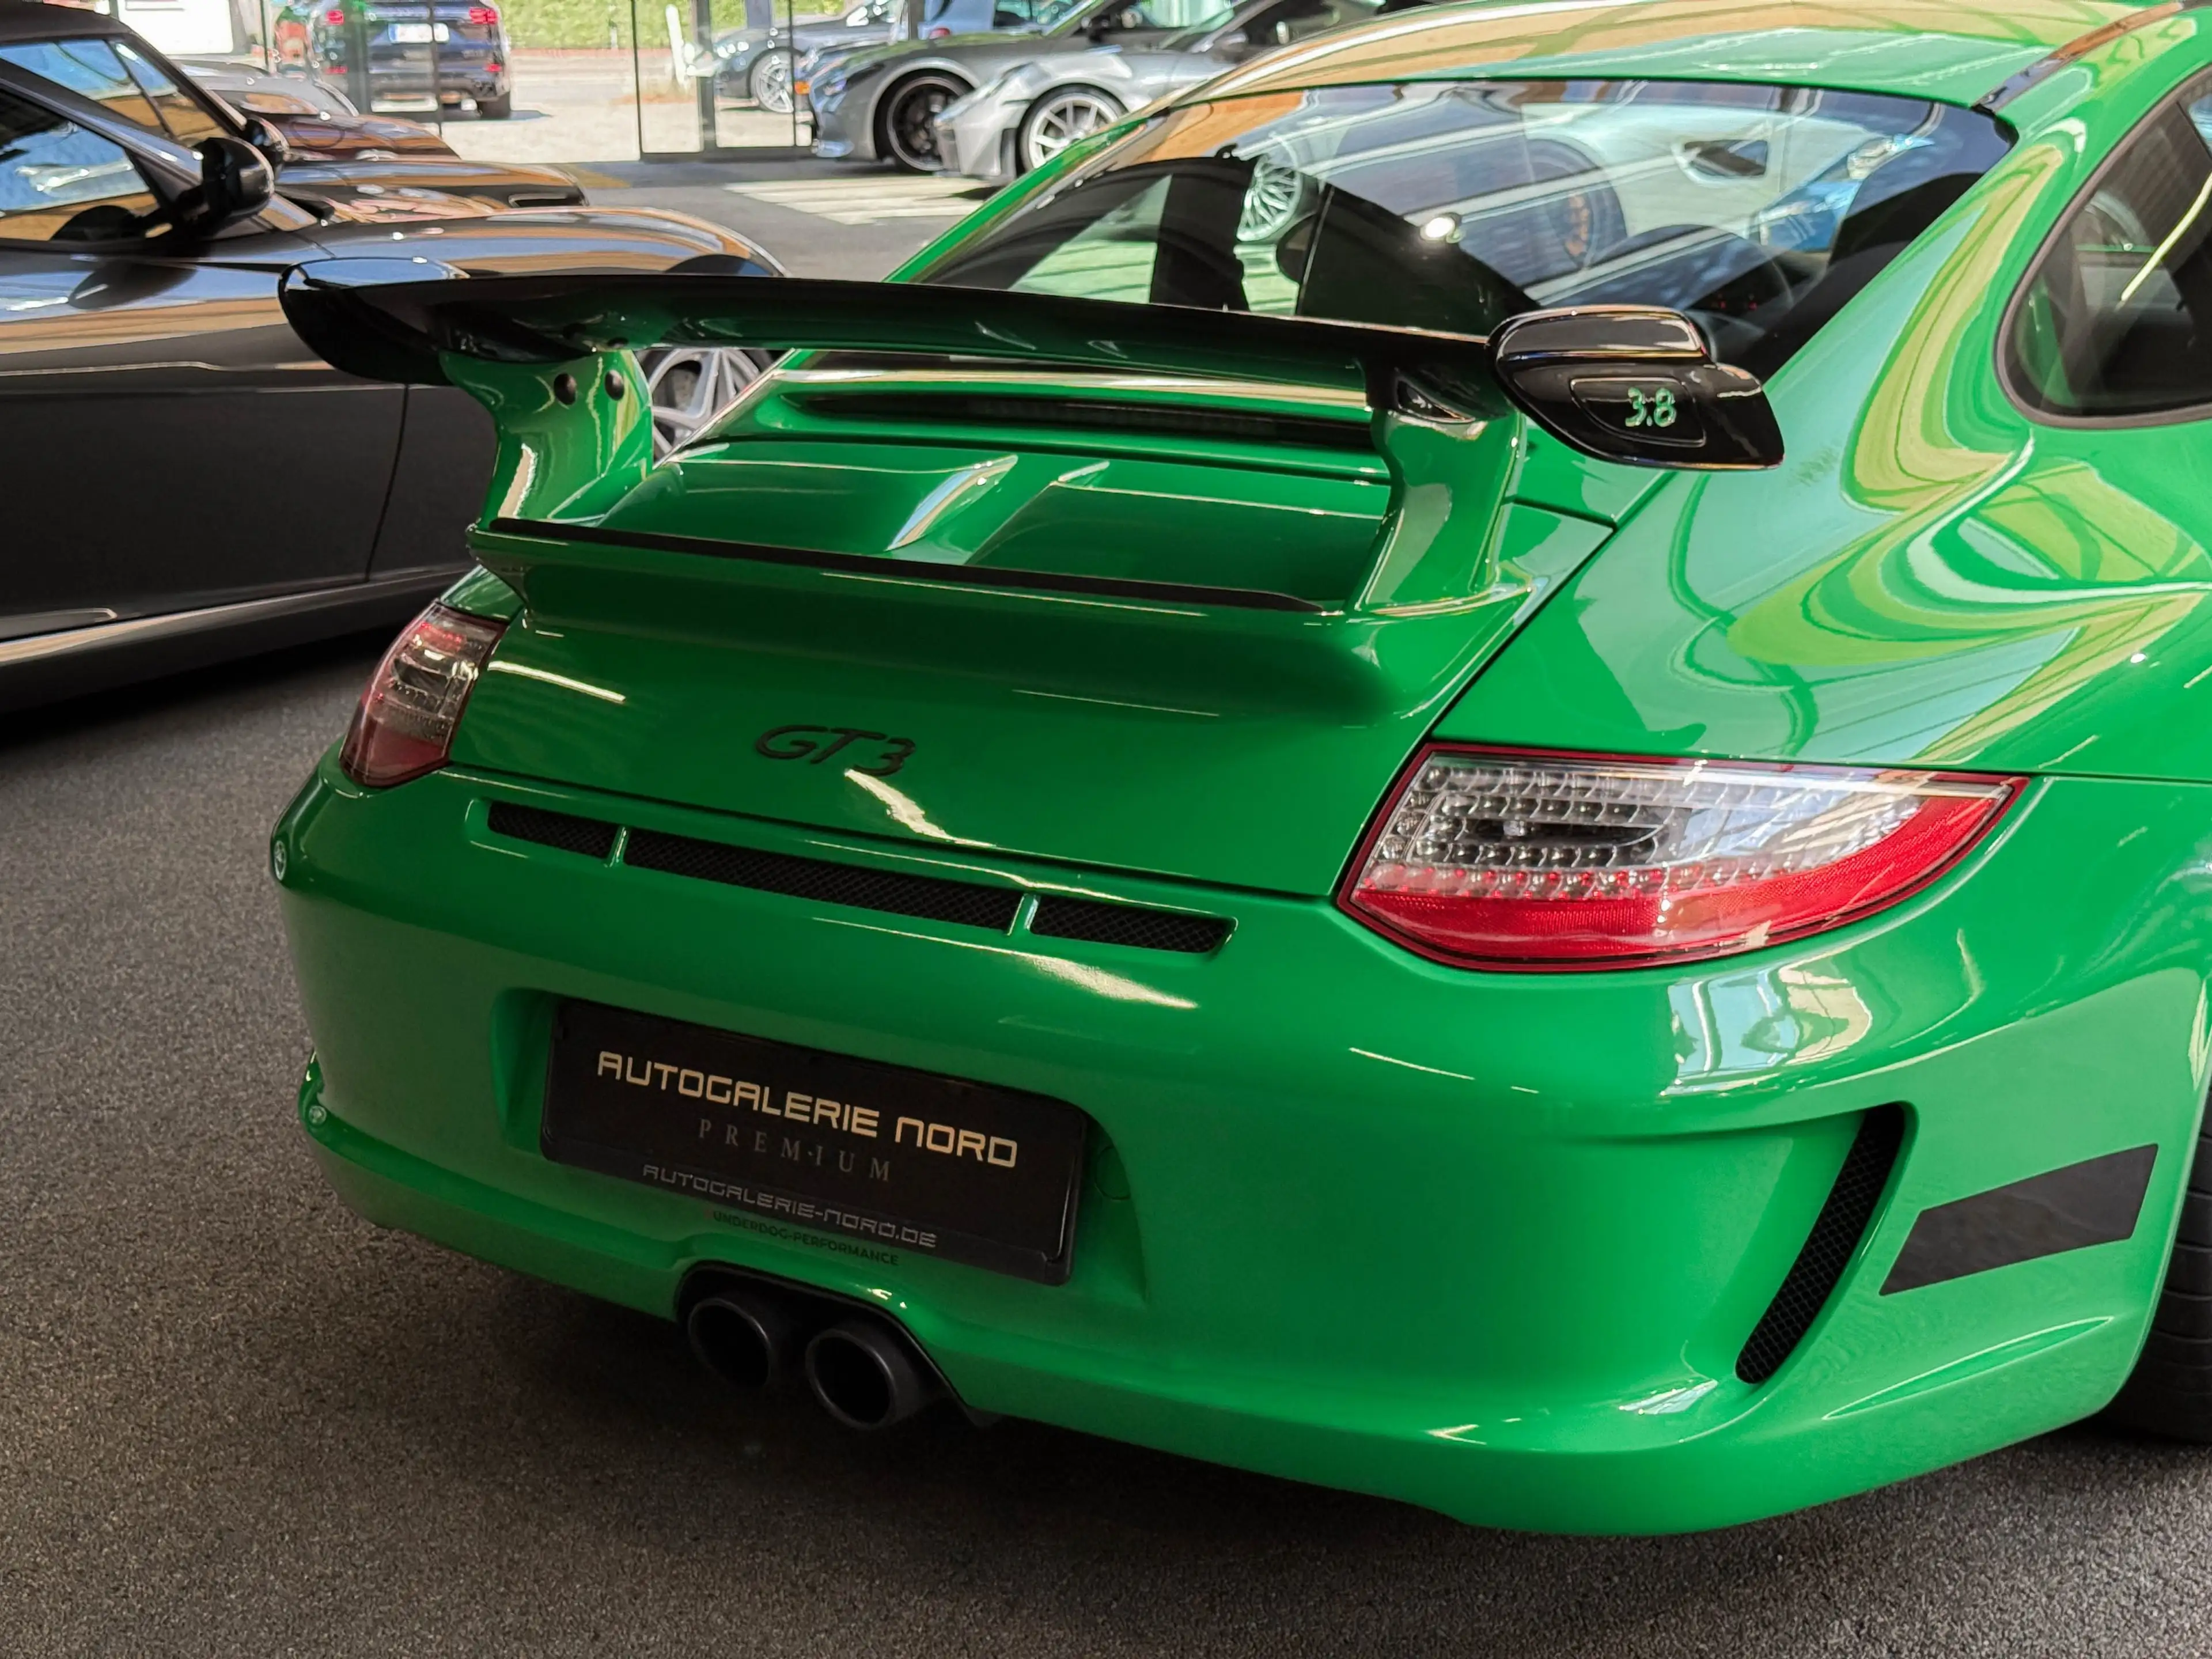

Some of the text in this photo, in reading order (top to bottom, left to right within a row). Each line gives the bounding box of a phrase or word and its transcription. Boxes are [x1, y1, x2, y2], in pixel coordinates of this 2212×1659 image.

[1625, 387, 1677, 427] 3.8
[755, 725, 915, 776] GT3
[597, 1051, 1017, 1168] AUTOGALERIE NORD
[698, 1118, 890, 1180] PREMIUM
[642, 1164, 937, 1248] AUTOGALERIE-NORD.DE
[713, 1211, 899, 1266] UNDERDOG-PERFORMANCE
